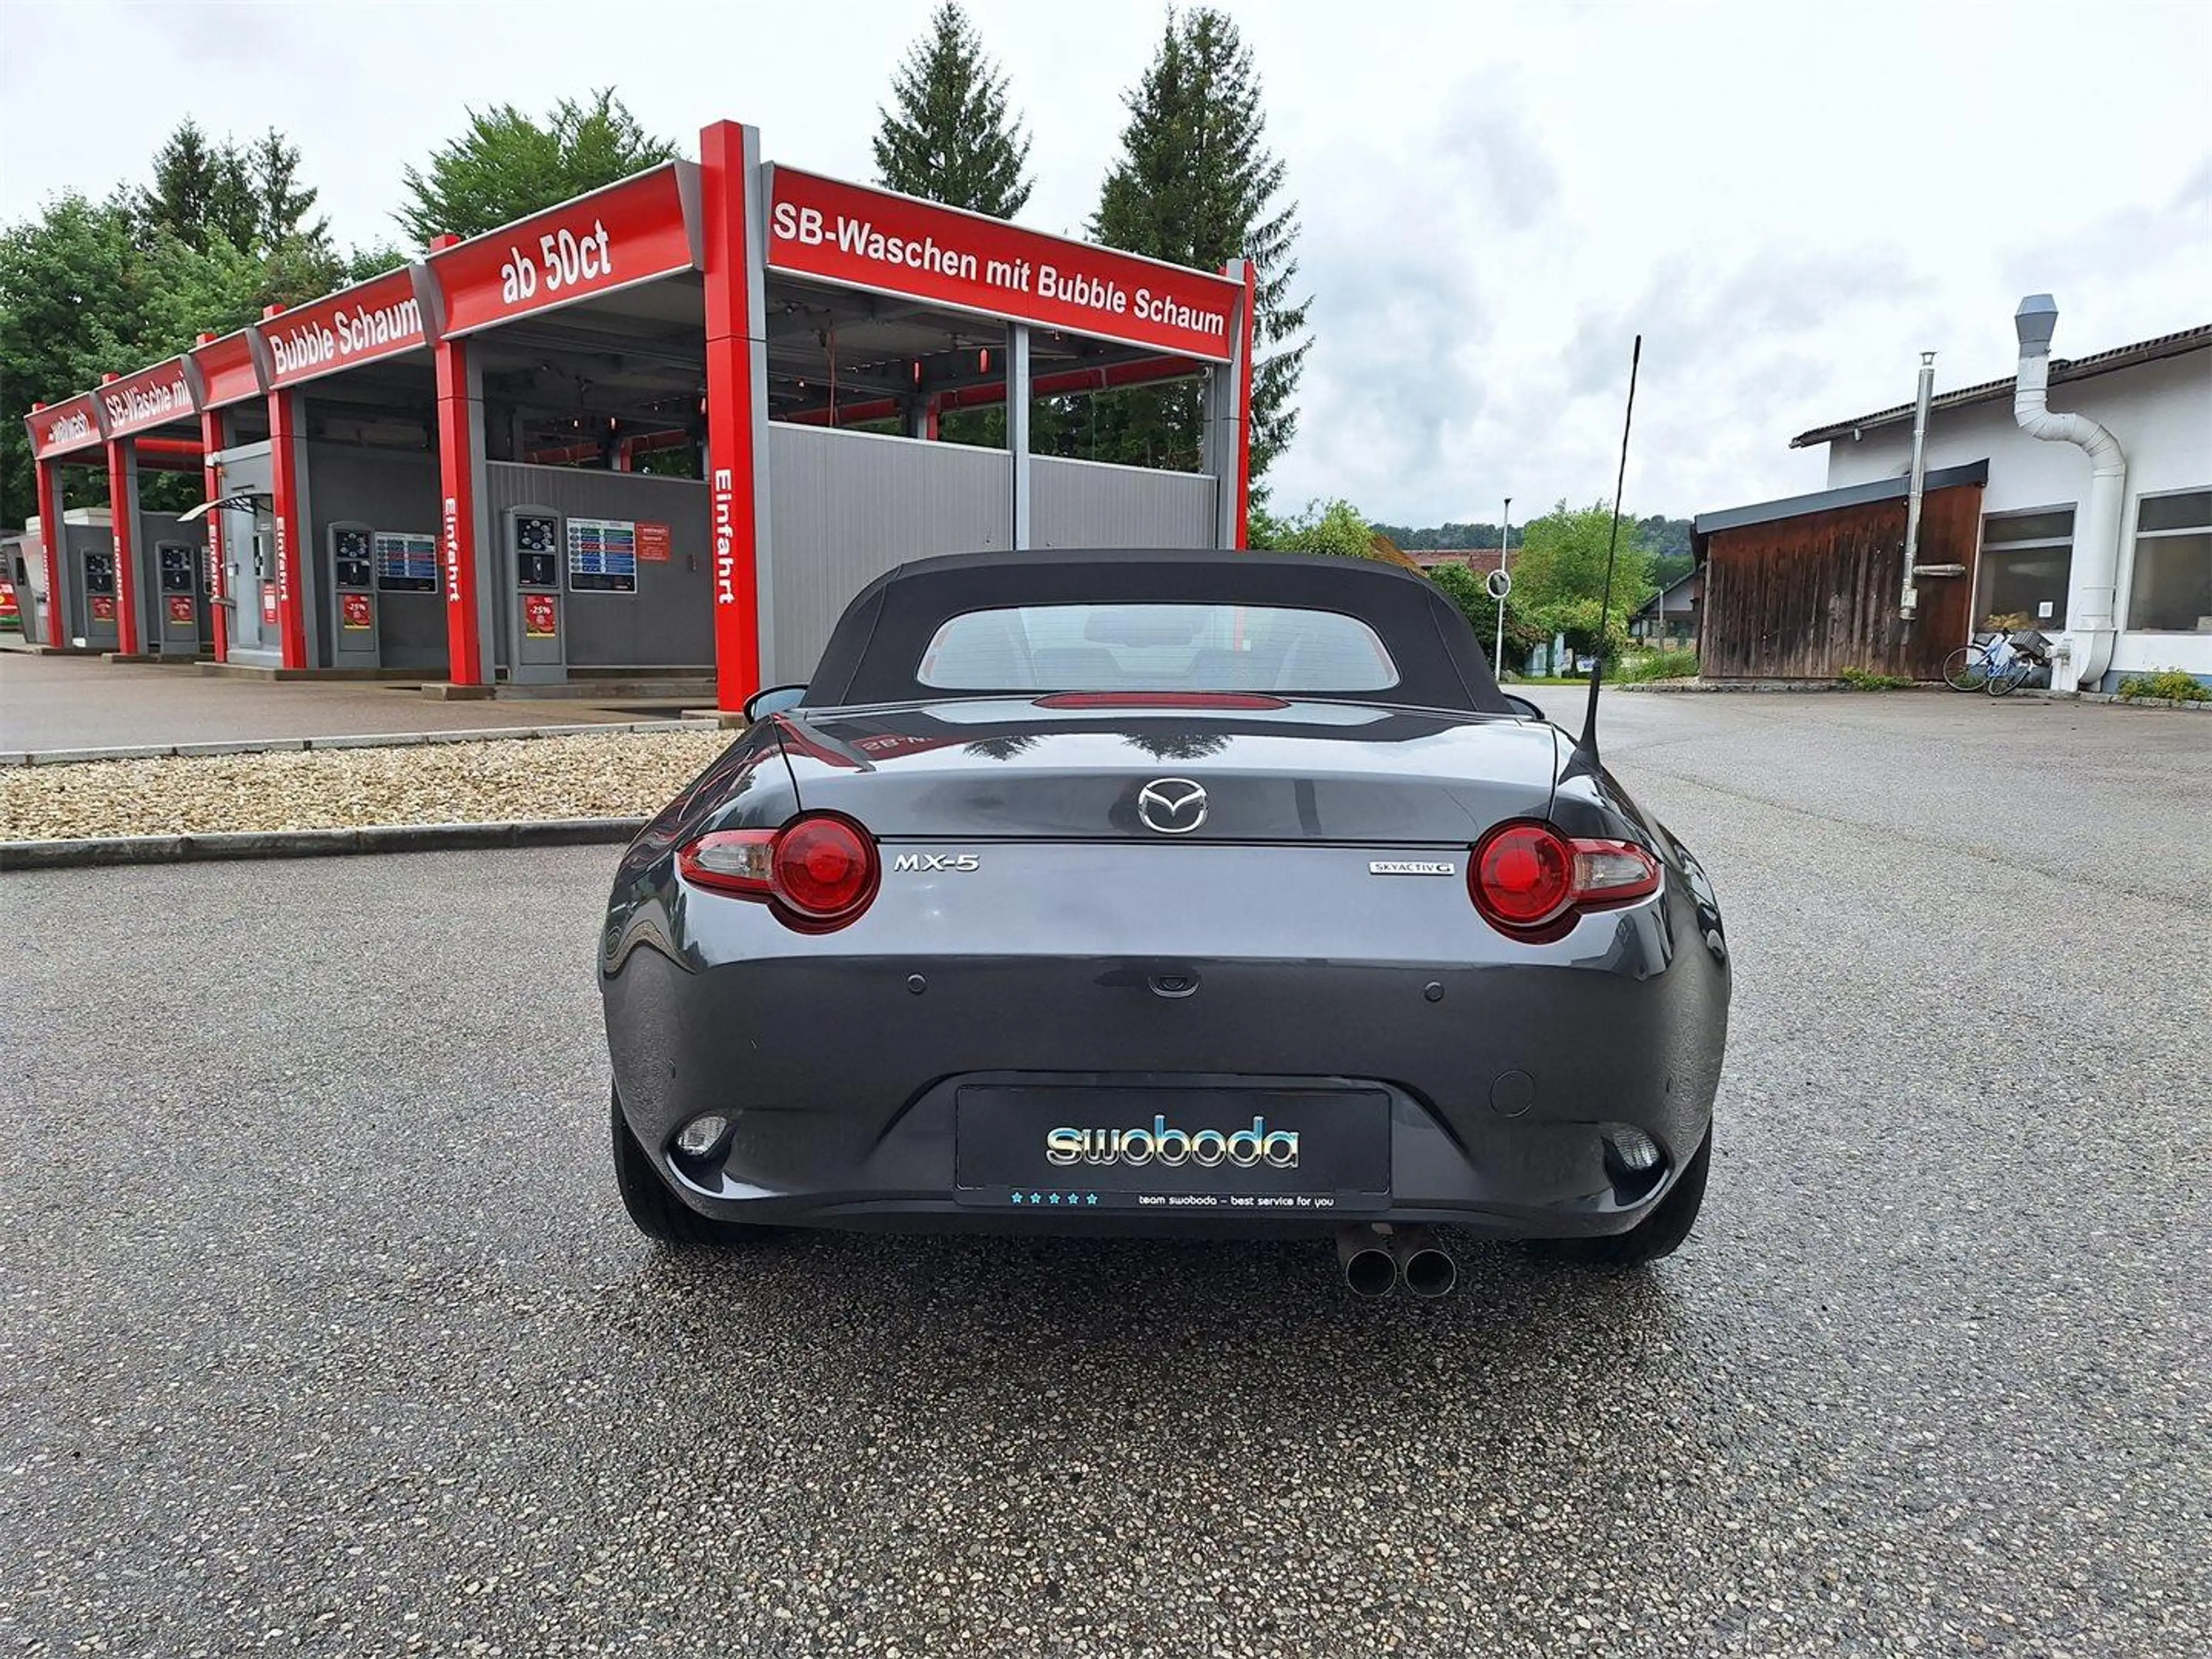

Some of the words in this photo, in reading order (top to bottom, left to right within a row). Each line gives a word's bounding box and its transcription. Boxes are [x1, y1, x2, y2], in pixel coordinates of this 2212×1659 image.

[501, 247, 537, 304] ab
[539, 218, 611, 291] 50ct
[772, 202, 977, 281] SB-Waschen
[986, 257, 1031, 291] mit
[1037, 264, 1126, 314] Bubble
[1133, 288, 1224, 336] Schaum
[268, 321, 334, 374] Bubble
[334, 297, 423, 355] Schaum
[445, 498, 460, 601] Einfahrt
[714, 468, 736, 604] Einfahrt
[893, 854, 980, 872] MX-5
[1046, 1114, 1300, 1169] swoboda
[1138, 1195, 1165, 1205] team
[1169, 1195, 1218, 1206] swoboda
[1230, 1195, 1254, 1206] best
[1257, 1196, 1294, 1206] service
[1296, 1196, 1311, 1206] for
[1314, 1198, 1335, 1208] you
